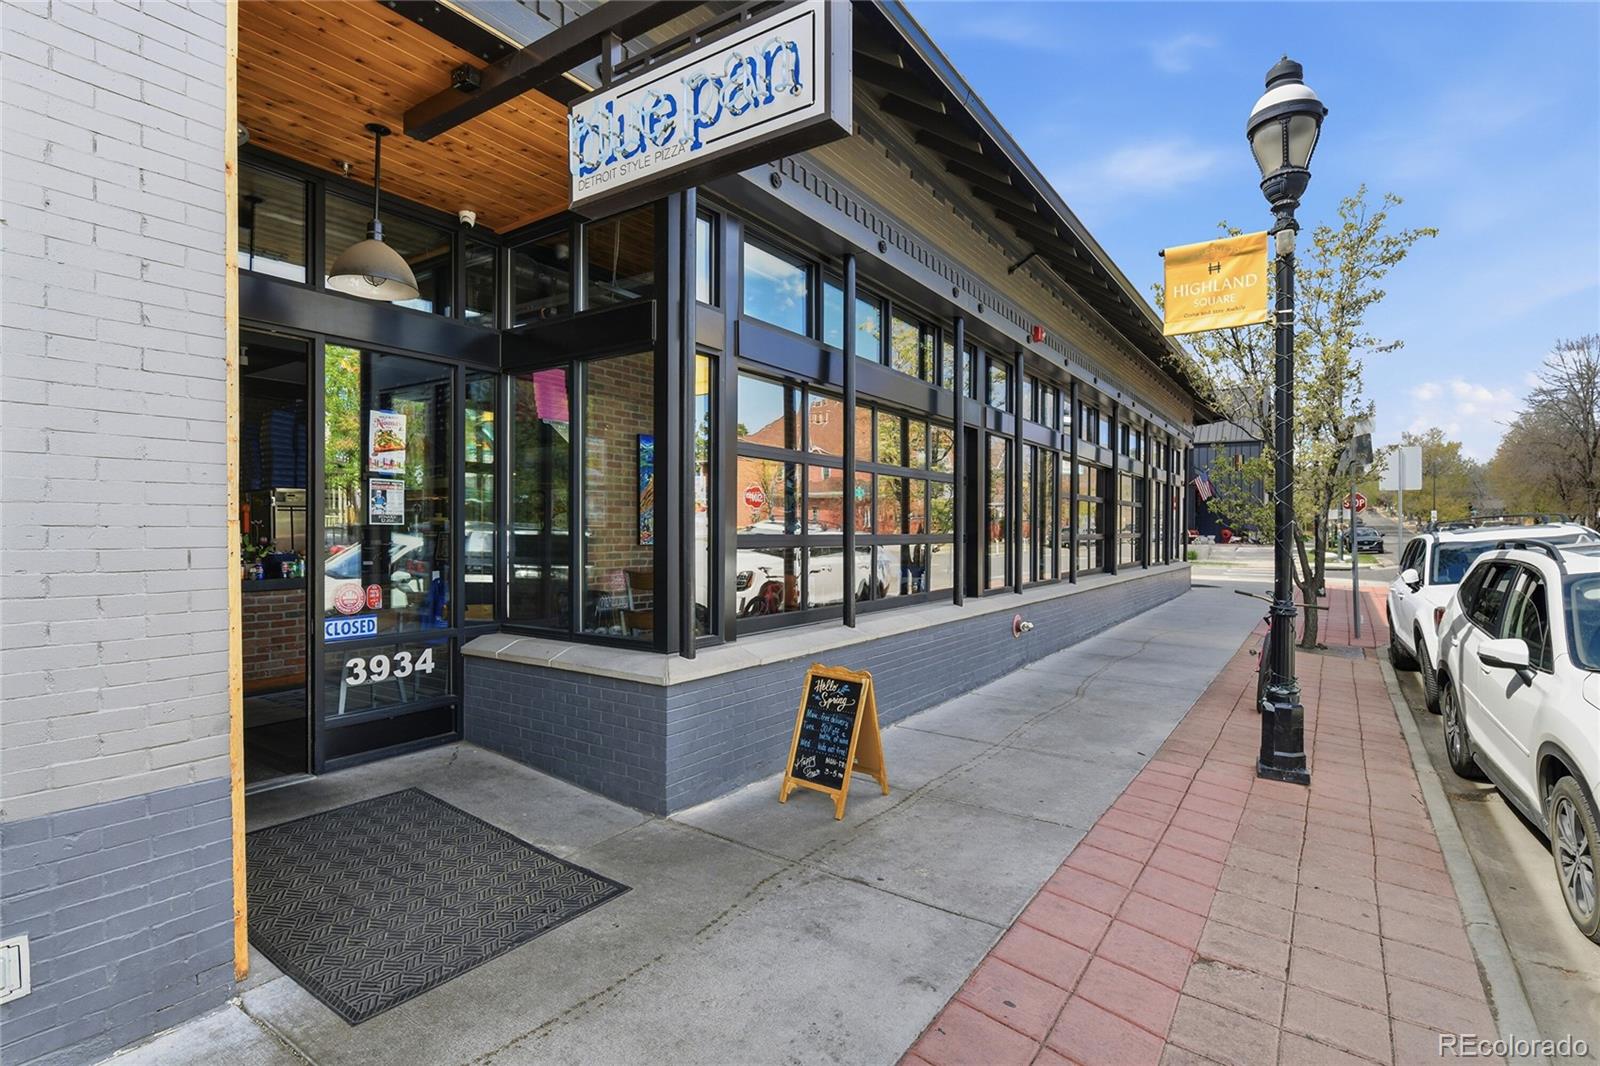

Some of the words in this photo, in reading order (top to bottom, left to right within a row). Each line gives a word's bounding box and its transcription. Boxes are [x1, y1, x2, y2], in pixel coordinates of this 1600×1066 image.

[569, 90, 678, 177] blue
[680, 36, 803, 151] pan
[578, 167, 617, 192] DETROIT
[619, 158, 651, 177] STYLE
[653, 144, 686, 164] PIZZA
[1173, 273, 1258, 298] HIGHLAND
[1193, 293, 1237, 308] SQUARE
[1344, 499, 1365, 507] SOP
[325, 619, 376, 637] CLOSED
[345, 647, 435, 686] 3934
[814, 679, 839, 693] Hello
[818, 691, 856, 712] Spring
